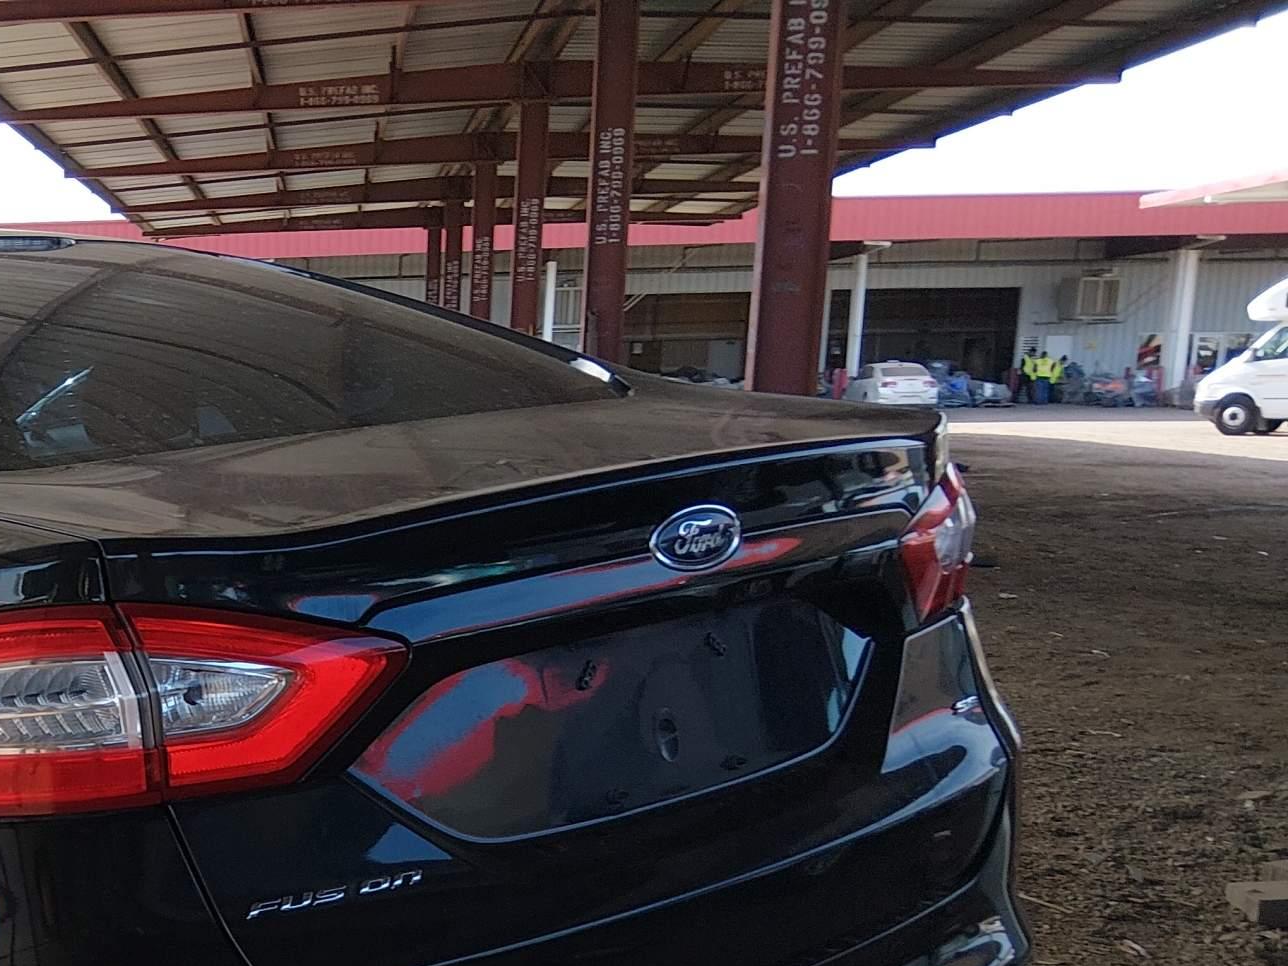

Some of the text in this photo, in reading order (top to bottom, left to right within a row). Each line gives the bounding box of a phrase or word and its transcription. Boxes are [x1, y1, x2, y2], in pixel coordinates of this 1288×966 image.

[782, 17, 807, 104] PREFAB
[777, 117, 800, 158] U.S.
[596, 160, 612, 213] PREFAB
[674, 518, 730, 555] Ford
[246, 868, 423, 921] FUSON
